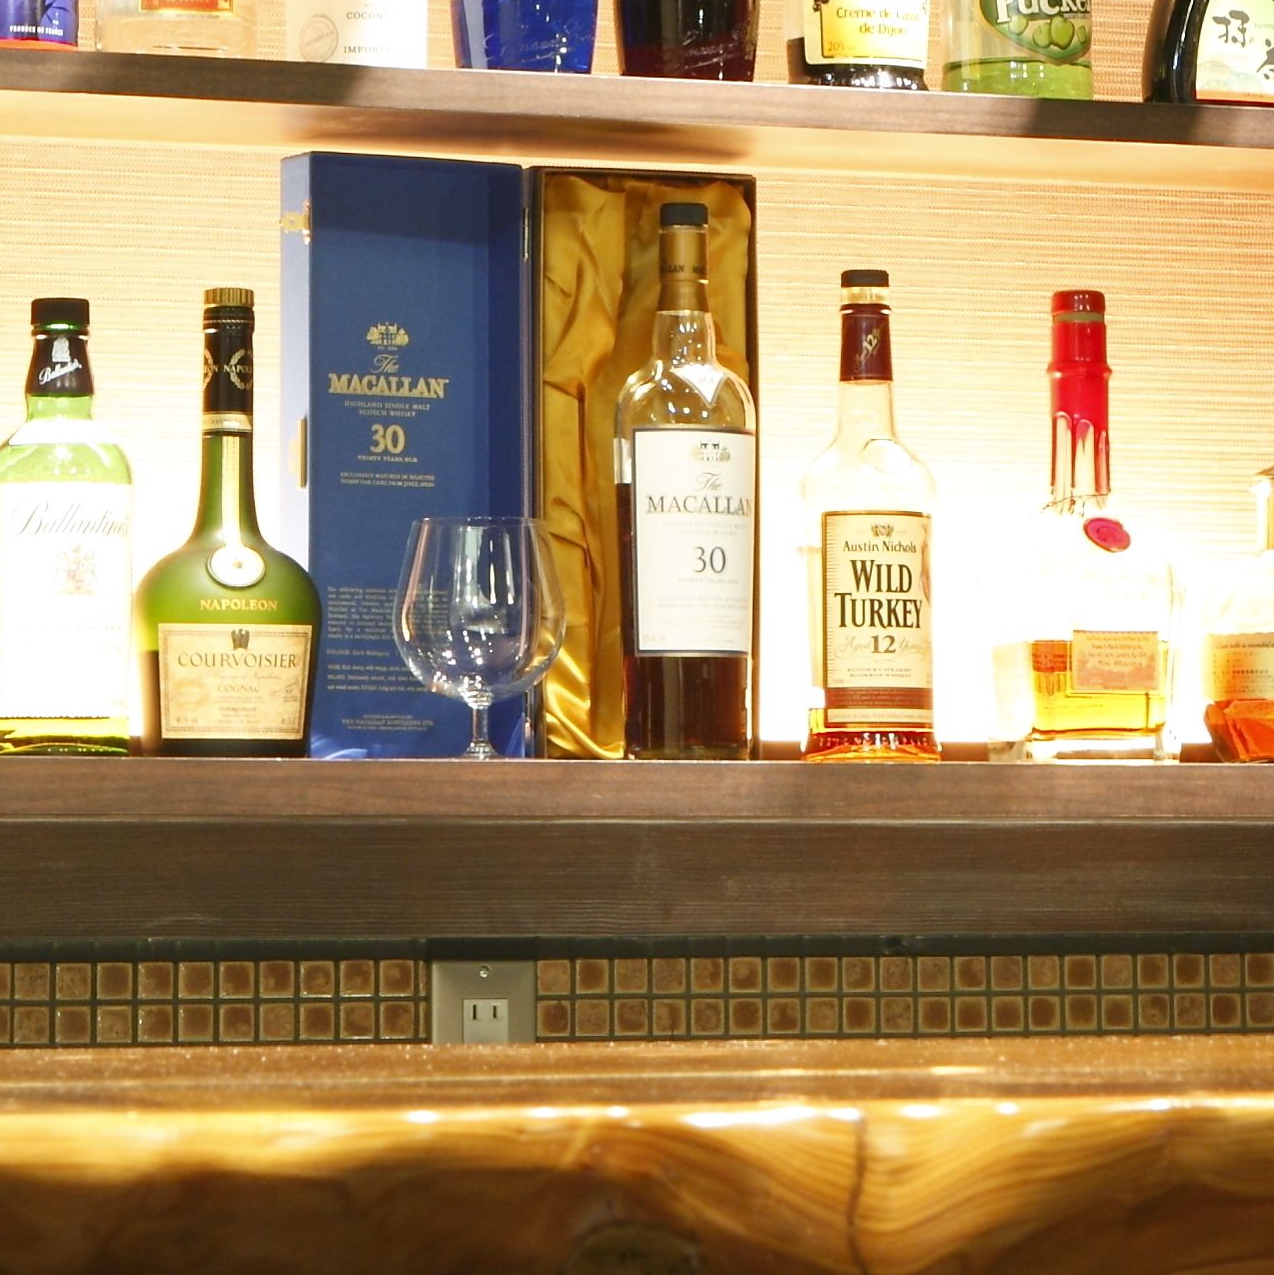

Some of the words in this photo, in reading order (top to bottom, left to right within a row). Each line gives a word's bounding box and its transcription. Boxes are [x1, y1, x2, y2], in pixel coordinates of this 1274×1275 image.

[859, 23, 874, 35] de
[372, 354, 399, 374] The
[328, 374, 445, 399] MACALLAN
[369, 423, 406, 455] 30
[695, 472, 723, 492] The
[843, 540, 879, 553] Austin
[882, 541, 917, 554] Nichols
[692, 546, 727, 574] 30
[850, 559, 913, 594] WILD
[200, 598, 278, 612] NAPOLEON
[834, 592, 923, 629] TURKEY
[871, 635, 896, 654] 12
[178, 652, 297, 669] COURVOISIER
